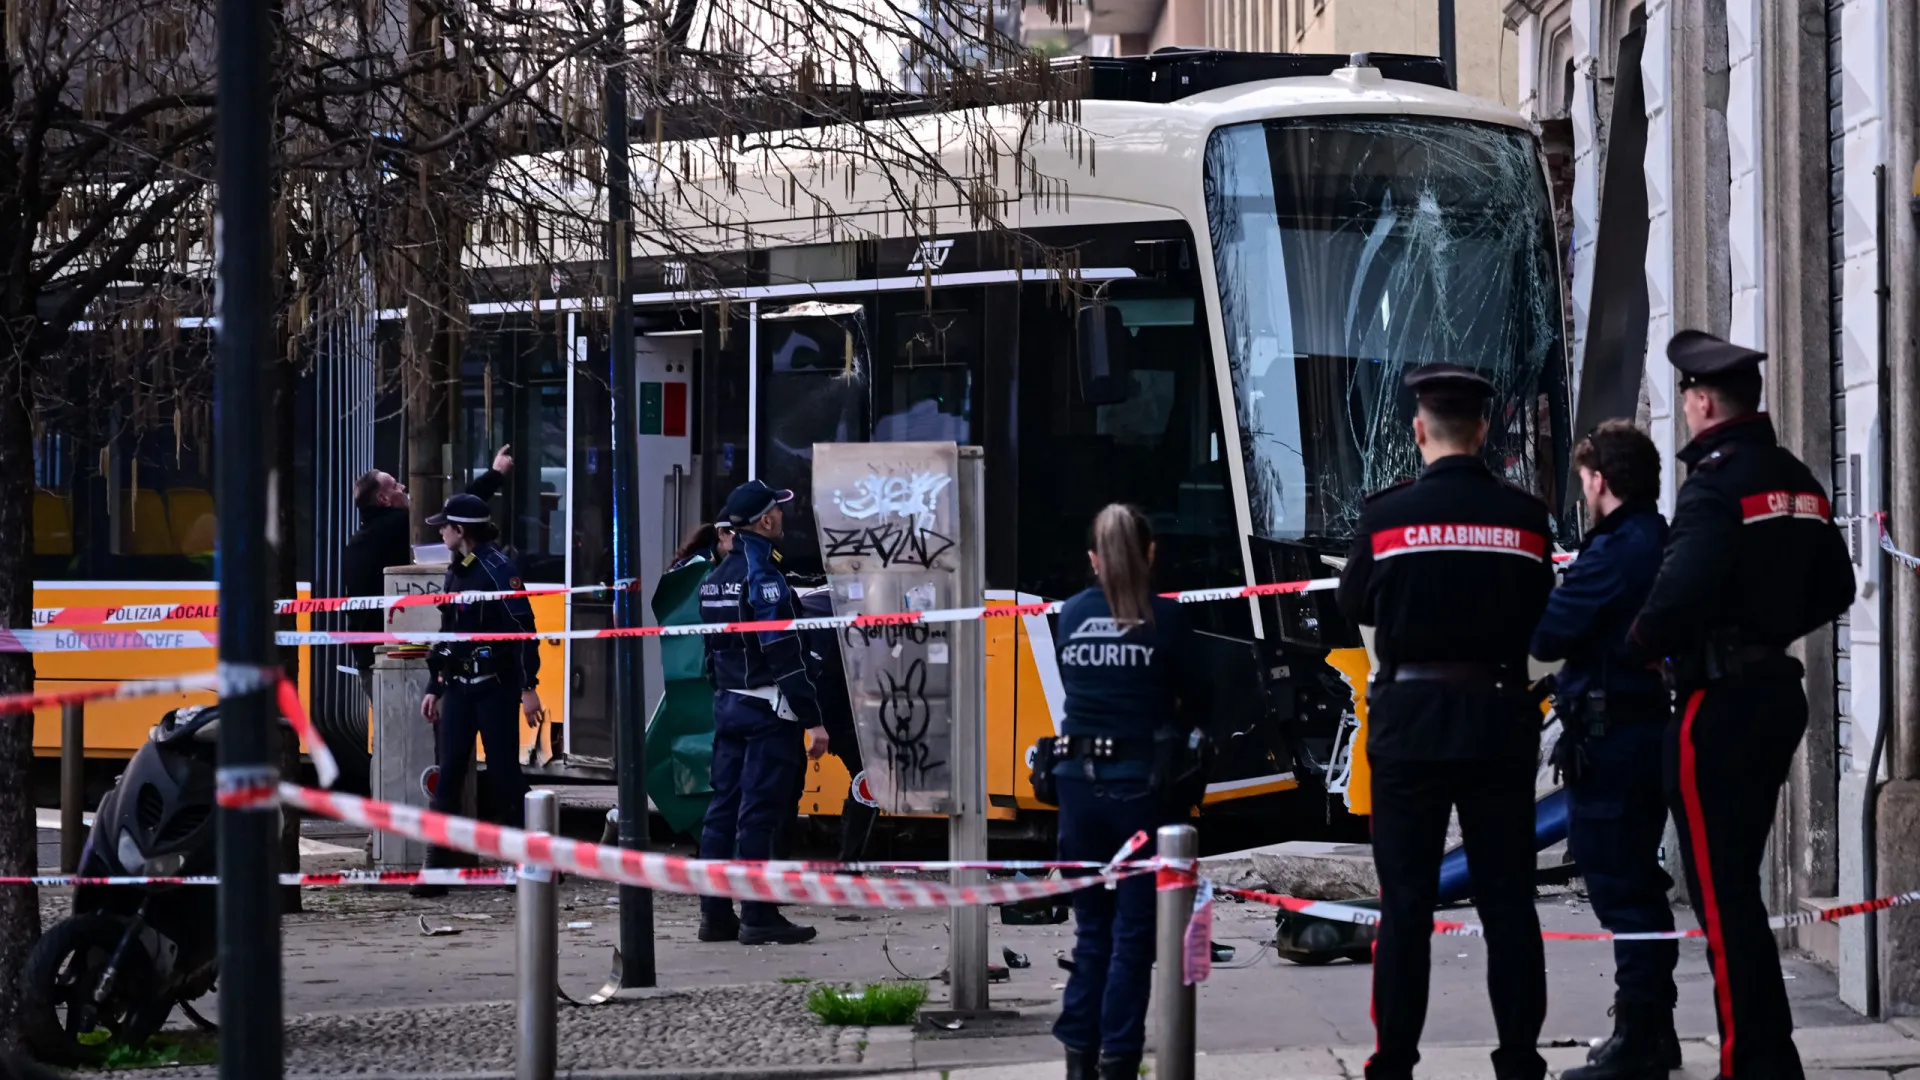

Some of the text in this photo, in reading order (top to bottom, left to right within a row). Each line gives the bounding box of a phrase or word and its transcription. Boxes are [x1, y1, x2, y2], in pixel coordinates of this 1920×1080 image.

[1403, 525, 1521, 548] CARABINIERI
[105, 604, 220, 621] POLIZIA LOCALE
[330, 599, 385, 612] LOCALE
[31, 610, 56, 624] ALE
[1061, 643, 1155, 667] SECURITY
